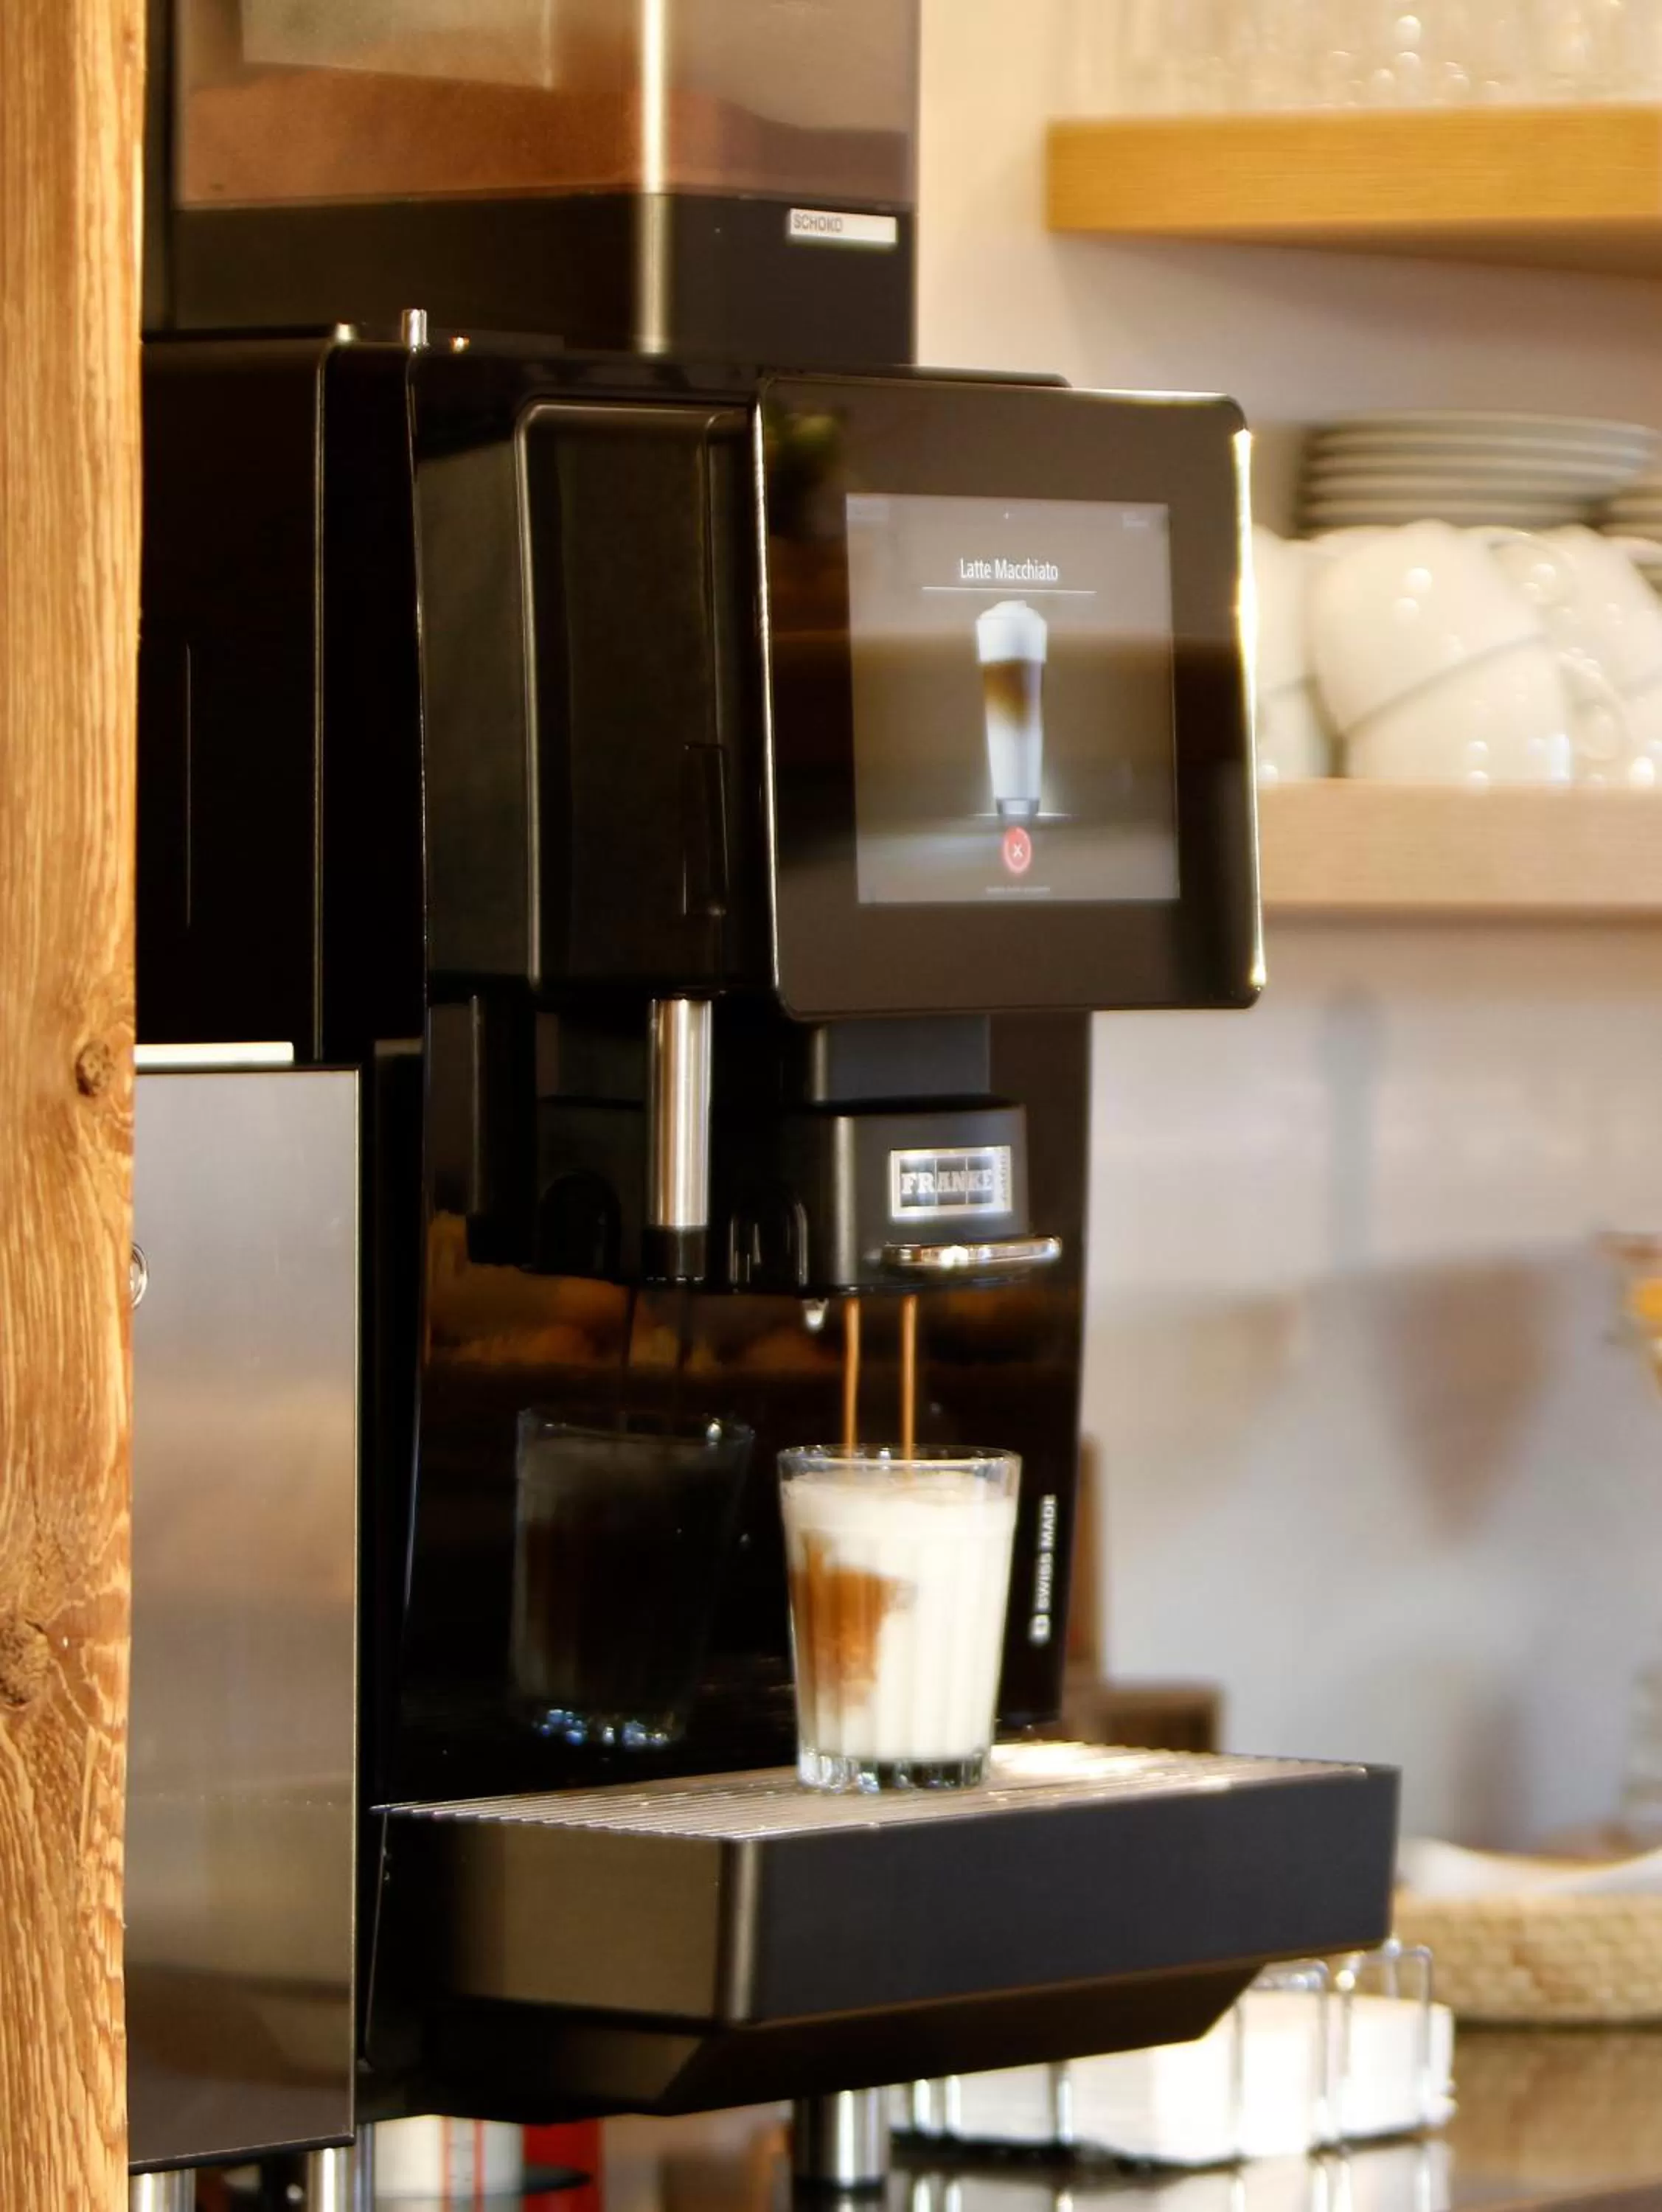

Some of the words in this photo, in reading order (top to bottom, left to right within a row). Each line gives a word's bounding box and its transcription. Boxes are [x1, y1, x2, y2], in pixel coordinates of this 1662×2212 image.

[793, 213, 844, 232] SCHOKO
[960, 557, 992, 579] Latte
[995, 557, 1059, 581] Macchiato
[900, 1169, 992, 1194] FRANKE
[1035, 1552, 1052, 1610] SWISS
